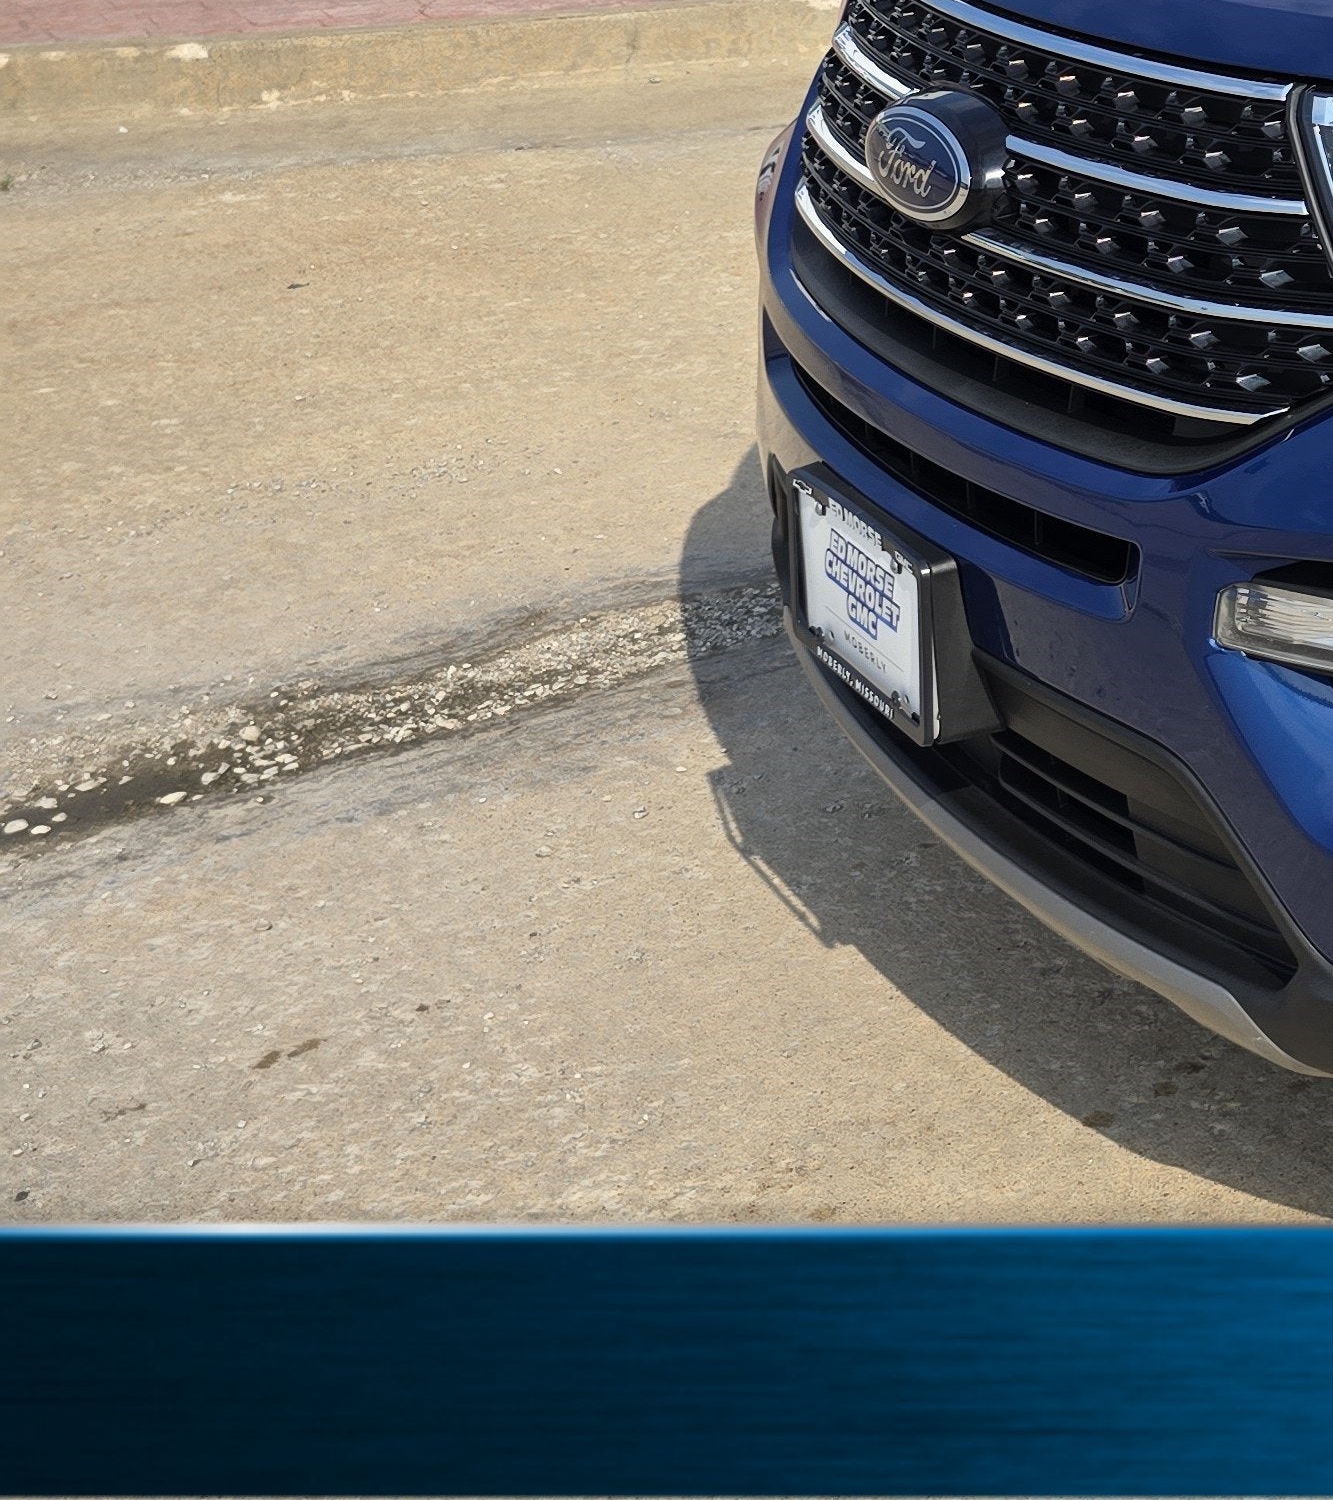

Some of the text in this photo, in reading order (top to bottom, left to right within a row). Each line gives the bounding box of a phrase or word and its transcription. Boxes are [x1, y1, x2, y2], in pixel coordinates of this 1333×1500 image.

[878, 126, 937, 198] Ford
[825, 548, 900, 632] CHEVROLET
[830, 528, 895, 600] ED MORSE
[847, 593, 878, 640] GMC
[854, 678, 894, 720] MISSOURI
